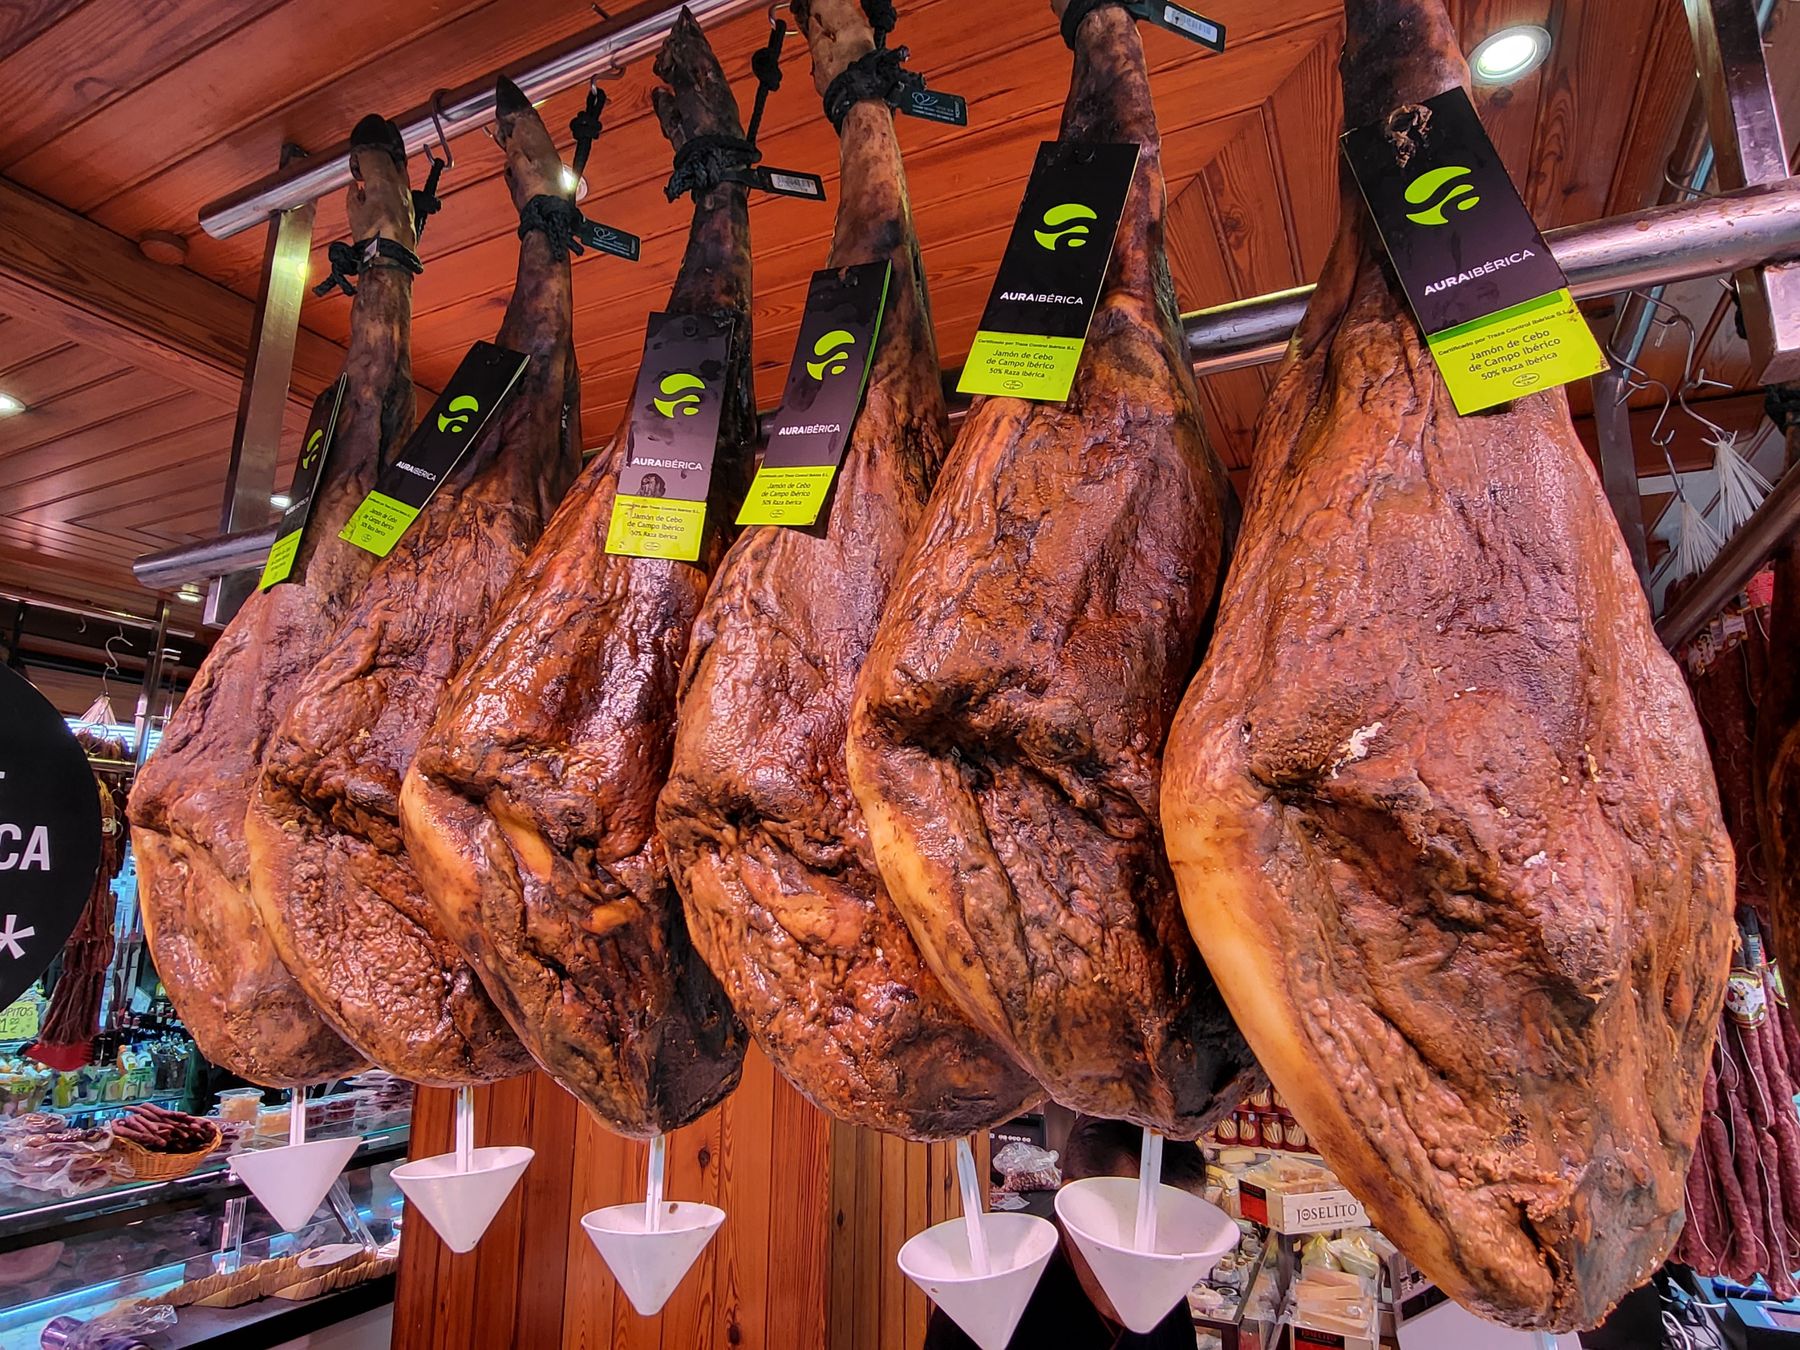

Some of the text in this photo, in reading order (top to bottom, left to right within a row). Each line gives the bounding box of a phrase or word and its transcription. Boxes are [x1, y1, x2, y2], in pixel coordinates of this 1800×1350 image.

[1424, 249, 1536, 296] AURAIBÉRICA
[1000, 291, 1084, 305] AURAIBÉRICA
[1470, 329, 1550, 361] Jamón de Cebo
[993, 349, 1053, 361] Jamón de Cebo
[1468, 337, 1561, 373] de Campo Ibérico
[986, 357, 1055, 370] de Campo Ibérico
[1481, 368, 1500, 381] 50%
[1501, 362, 1524, 375] Raza
[1526, 351, 1558, 366] Ibérica
[989, 367, 1003, 375] 50%
[1004, 368, 1020, 376] Raza
[778, 423, 841, 436] AURAIBÉRICA
[395, 460, 437, 482] AURAIBÉRICA
[632, 457, 703, 471] AURAIBÉRICA
[632, 512, 683, 524] Jamón de Cebo
[637, 521, 660, 530] Campo
[1296, 1203, 1357, 1224] JOSELITO
